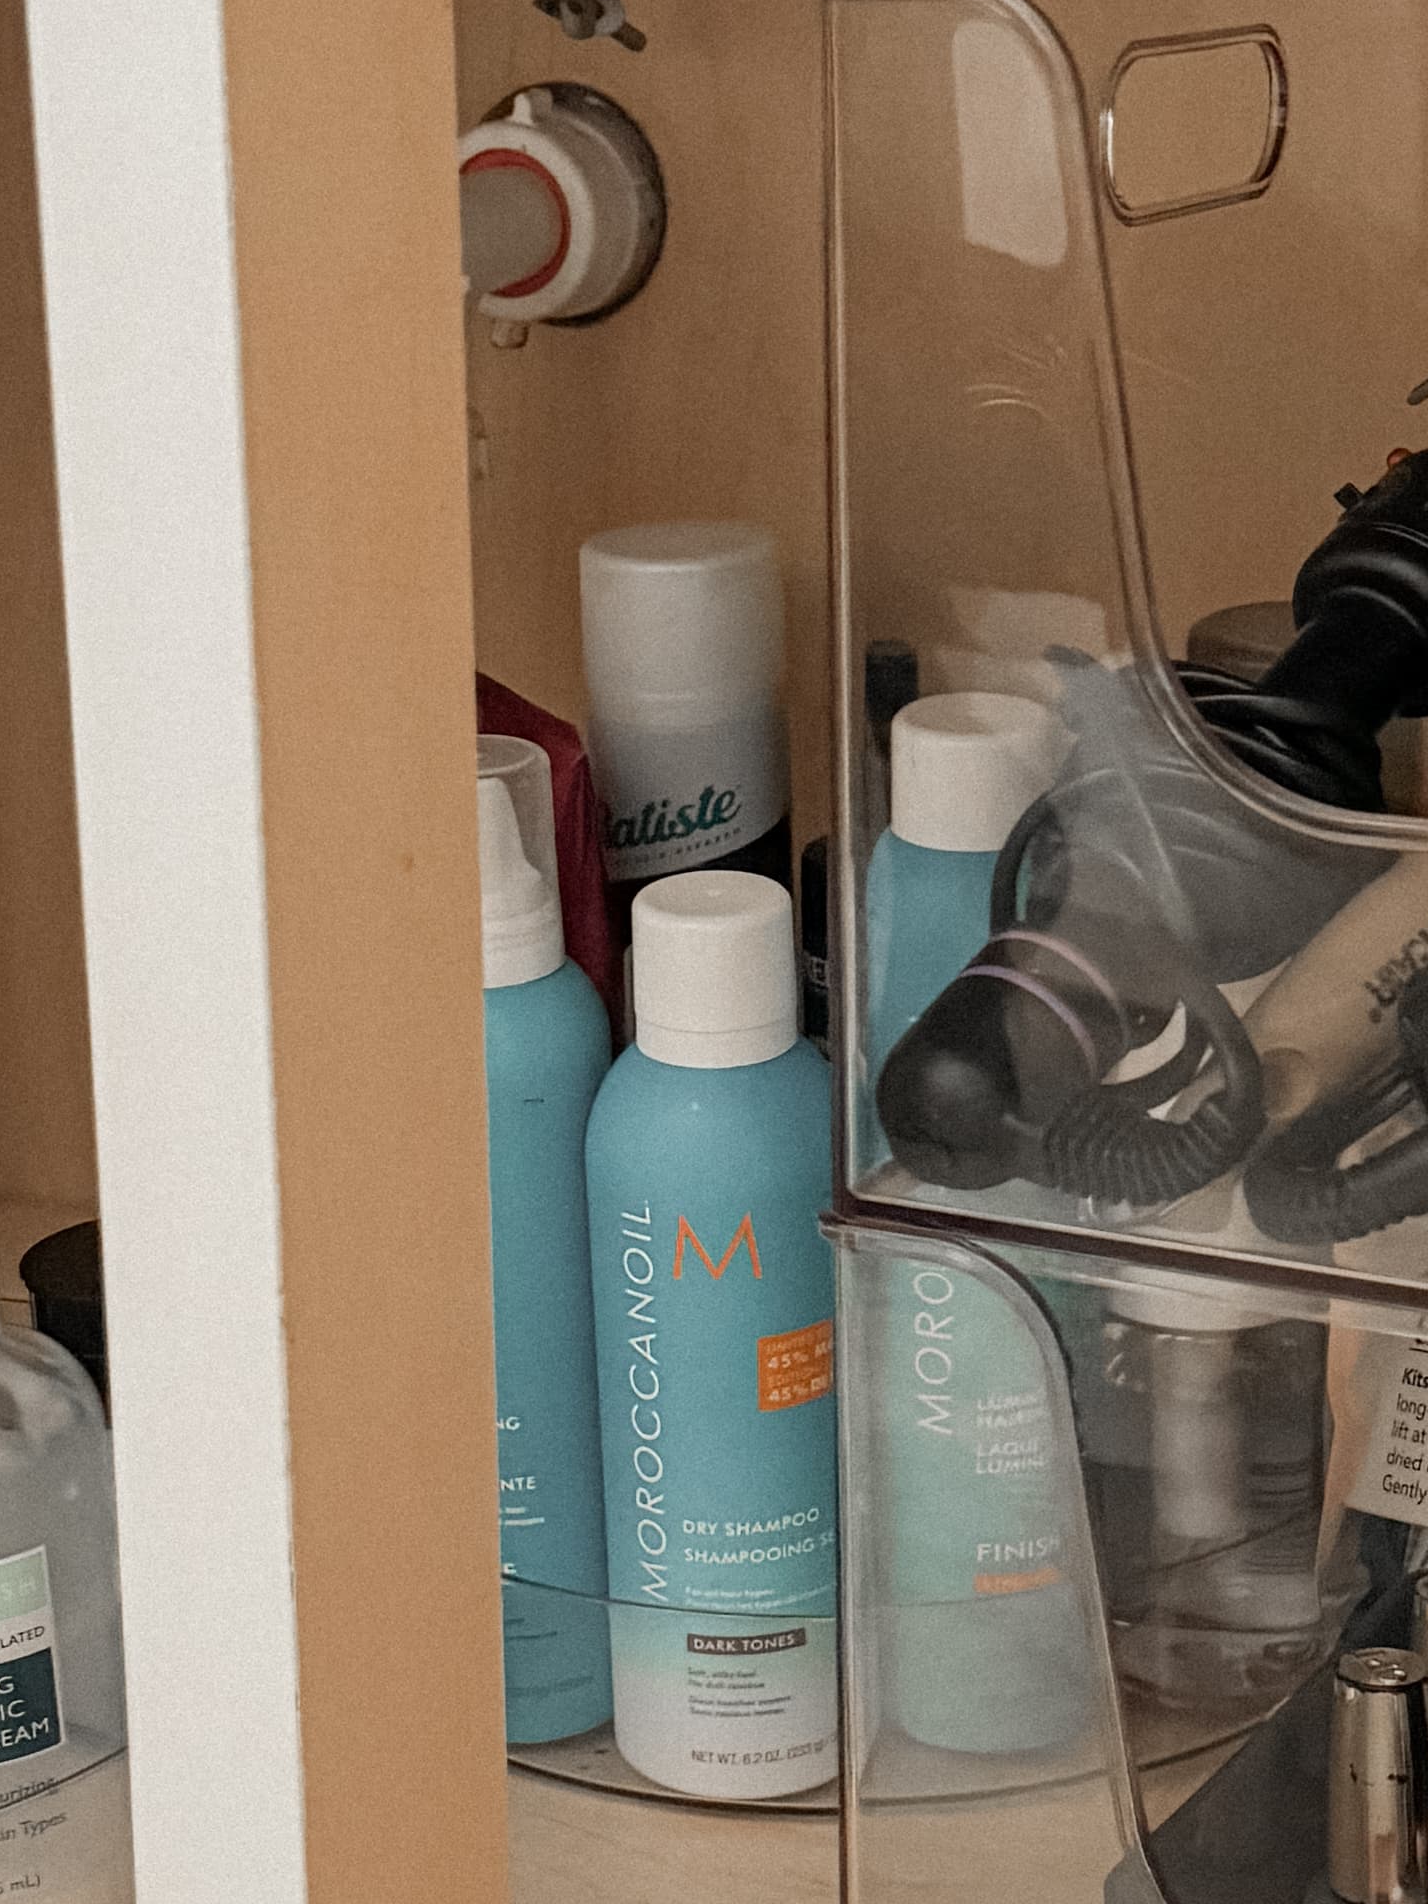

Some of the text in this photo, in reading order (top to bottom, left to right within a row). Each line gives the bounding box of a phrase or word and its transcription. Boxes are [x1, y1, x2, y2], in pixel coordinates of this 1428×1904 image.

[605, 784, 742, 849] atiste
[672, 1210, 763, 1281] M
[912, 1266, 955, 1435] MORO
[620, 1205, 671, 1603] MOROCCANOIL
[1390, 1418, 1410, 1440] lift
[1411, 1427, 1427, 1445] at
[1385, 1447, 1423, 1473] dried
[1381, 1473, 1428, 1506] Gently
[683, 1507, 820, 1537] DRY SHAMPOO
[684, 1530, 837, 1565] SHAMPOOING SE
[693, 1632, 796, 1652] DARK TONES
[19, 1811, 69, 1839] Types
[9, 1873, 42, 1892] mL)
